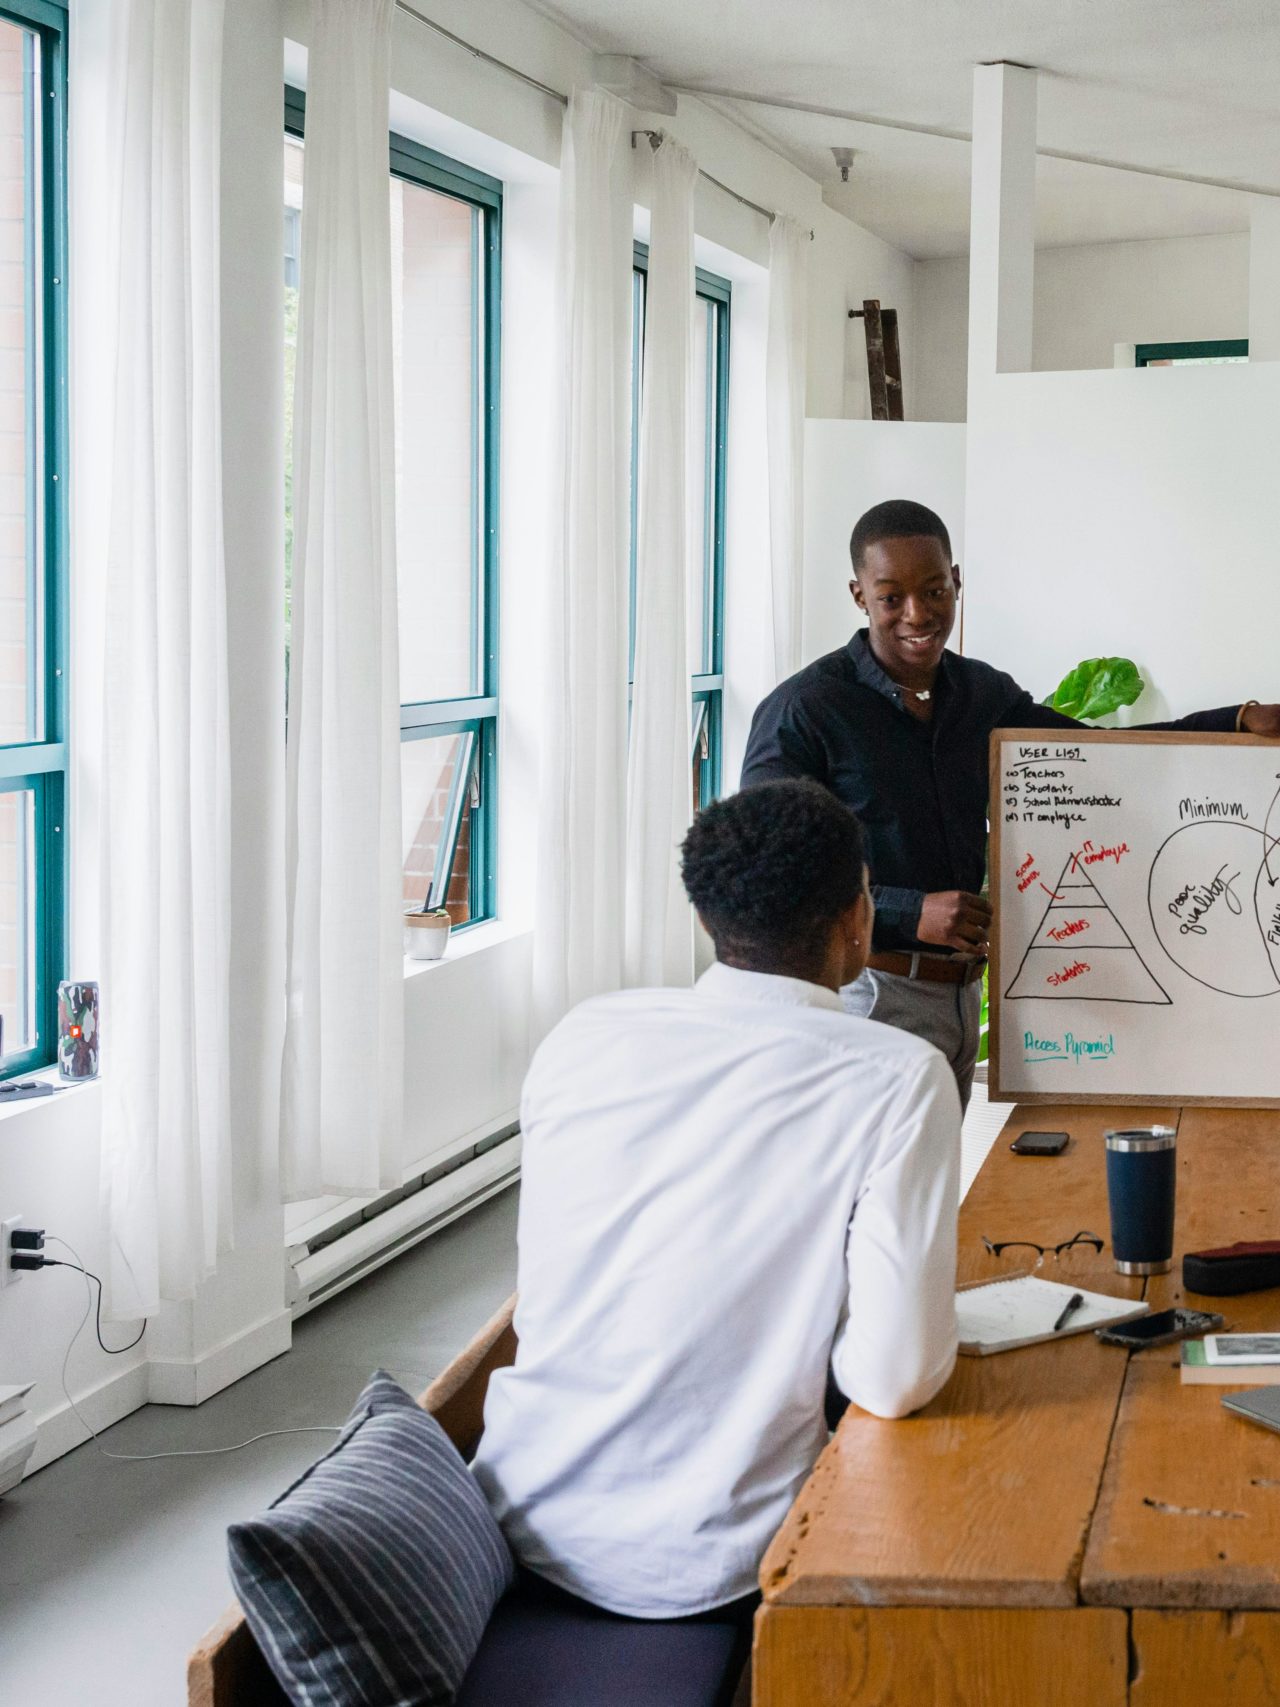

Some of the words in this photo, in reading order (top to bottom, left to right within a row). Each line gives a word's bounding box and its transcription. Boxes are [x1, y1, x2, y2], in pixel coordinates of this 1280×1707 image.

[1019, 747, 1049, 758] USER
[1056, 747, 1080, 759] LIST
[1020, 766, 1065, 779] Teachers
[1025, 781, 1073, 795] Students
[1023, 797, 1051, 808] School
[1054, 794, 1122, 807] Administrator
[1178, 797, 1249, 821] Minimum
[1005, 812, 1019, 822] (d)
[1023, 812, 1034, 822] IT
[1037, 810, 1087, 829] employee
[1083, 840, 1094, 852] IT
[1083, 842, 1130, 865] employee
[1179, 863, 1243, 935] quality
[1046, 918, 1090, 942] Teachers
[1046, 960, 1091, 986] Students
[1024, 1032, 1061, 1052] Access
[1065, 1032, 1115, 1064] Pyramid
